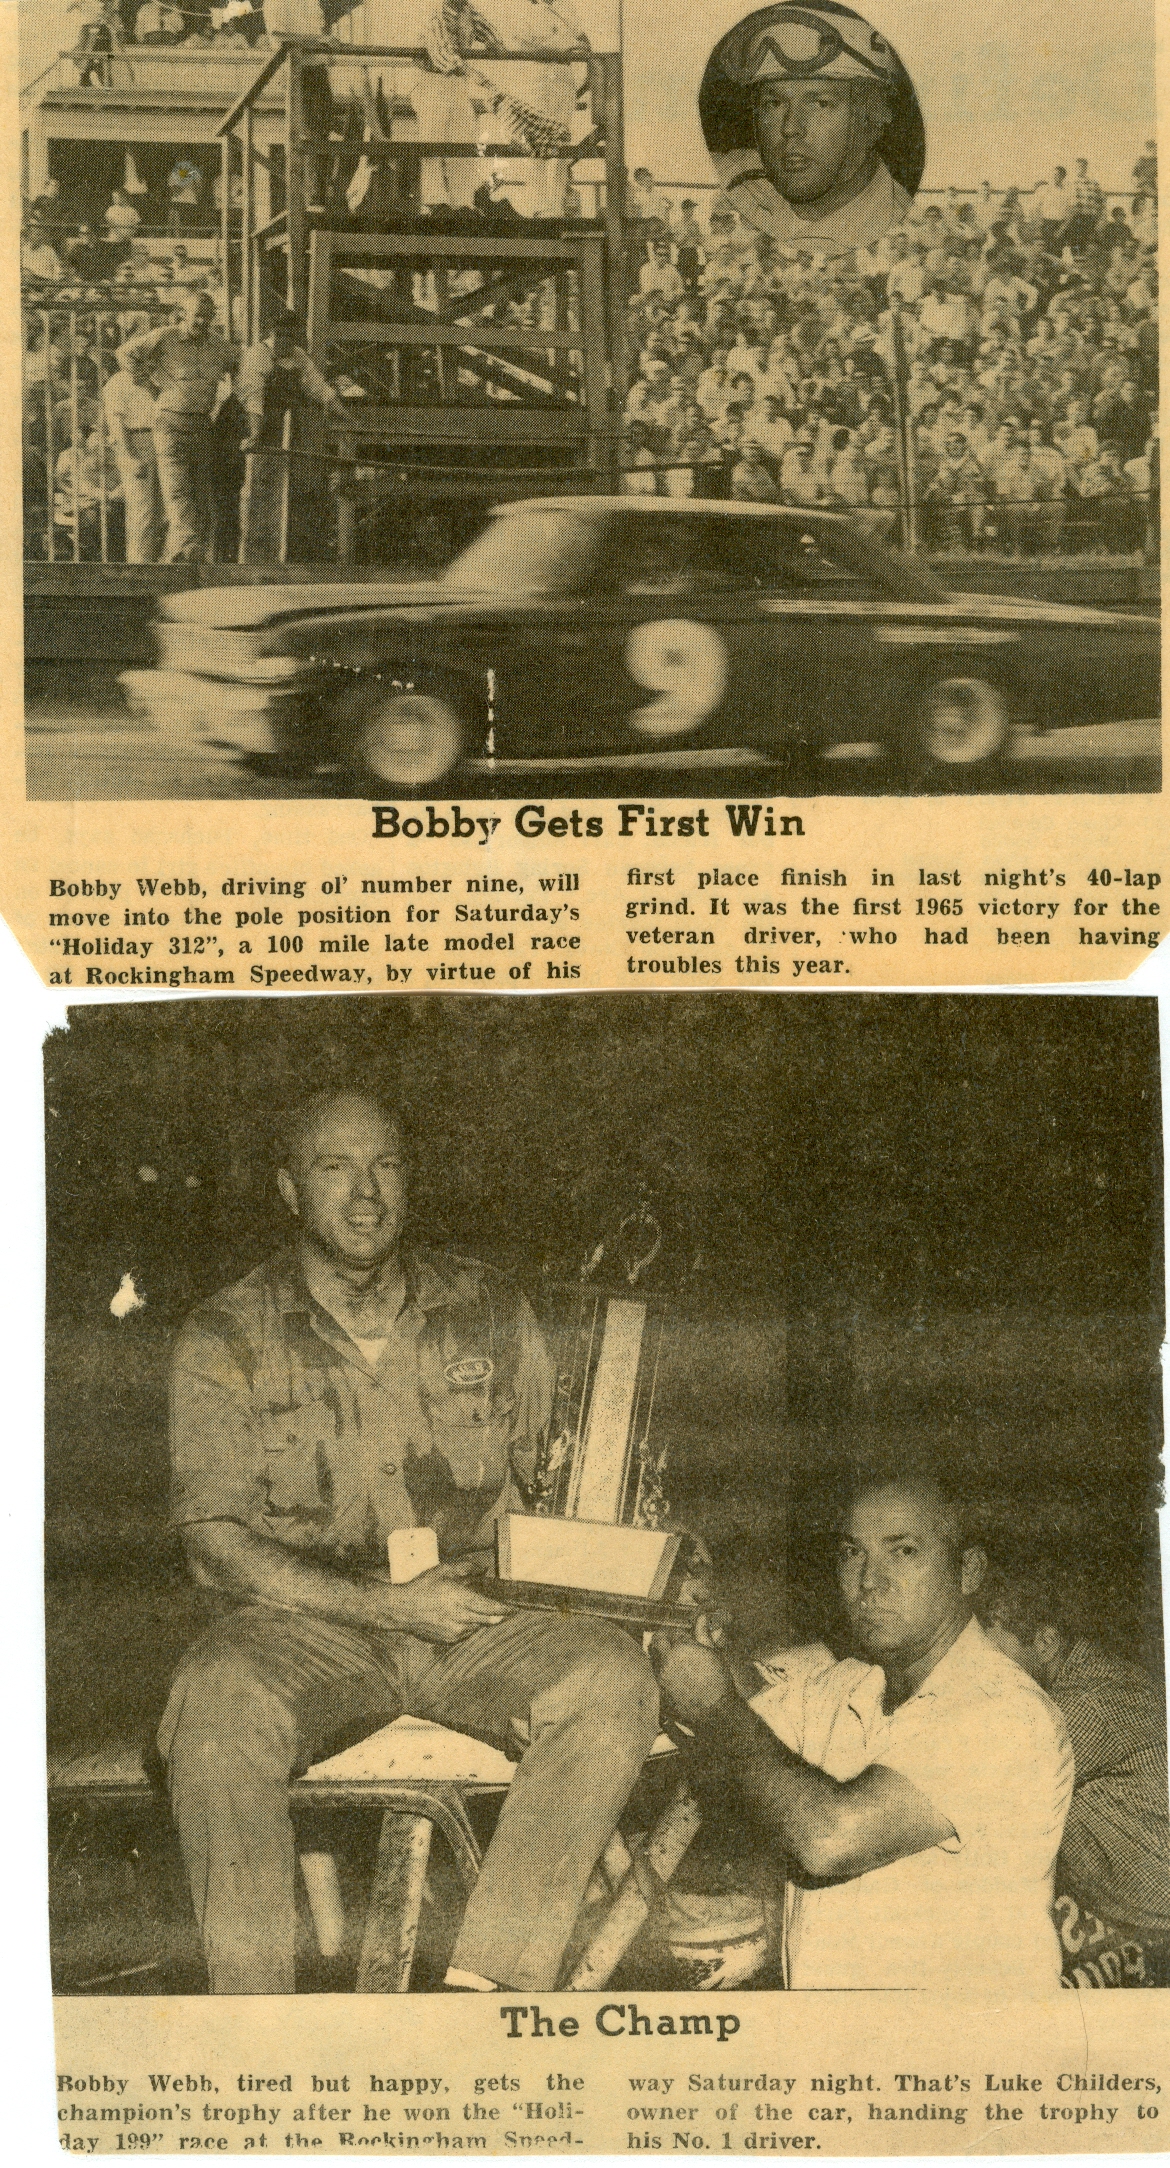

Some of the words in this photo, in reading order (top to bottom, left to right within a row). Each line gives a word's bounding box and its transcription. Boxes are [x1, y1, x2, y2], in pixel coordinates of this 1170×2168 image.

[624, 620, 727, 737] 9
[371, 804, 502, 845] Bobby
[514, 804, 604, 838] Gets
[617, 803, 710, 838] First
[725, 804, 806, 837] Win
[48, 878, 122, 901] Bobby
[135, 877, 207, 899] Webb,
[221, 876, 307, 899] driving
[361, 875, 453, 894] number
[466, 874, 524, 895] nine,
[538, 873, 580, 892] will
[626, 867, 676, 886] first
[697, 867, 759, 890] place
[780, 867, 848, 887] finish
[871, 868, 895, 887] in
[918, 868, 962, 887] last
[1087, 868, 1162, 891] 40-lap
[48, 912, 110, 927] move
[123, 907, 170, 927] into
[183, 907, 222, 926] the
[235, 906, 284, 929] pole
[297, 905, 392, 928] position
[406, 904, 440, 923] for
[625, 897, 695, 919] grind.
[709, 897, 730, 916] It
[742, 901, 787, 916] was
[800, 896, 840, 916] the
[852, 897, 902, 916] first
[915, 897, 964, 916] 1965
[977, 897, 1060, 920] victory
[1073, 897, 1109, 916] for
[1121, 897, 1160, 916] the
[238, 940, 253, 954] a
[267, 935, 304, 954] 100
[318, 934, 370, 953] mile
[384, 933, 429, 953] late
[444, 932, 515, 951] model
[530, 936, 581, 950] race
[625, 926, 716, 945] veteran
[744, 926, 821, 948] driver,
[848, 926, 898, 945] who
[924, 926, 969, 945] had
[996, 927, 1051, 945] been
[1078, 926, 1161, 949] having
[49, 967, 73, 985] at
[85, 965, 235, 988] Rockingham
[250, 964, 373, 987] Speedway,
[385, 963, 413, 984] by
[425, 962, 496, 981] virtue
[508, 961, 532, 980] of
[546, 960, 582, 979] his
[626, 955, 722, 974] troubles
[734, 954, 781, 975] this
[792, 959, 850, 978] year.
[500, 2005, 580, 2039] The
[595, 2003, 741, 2043] Champ
[56, 2074, 130, 2096] Bobby
[147, 2074, 219, 2095] Webb,
[236, 2073, 293, 2092] tired
[310, 2074, 351, 2093] but
[369, 2074, 450, 2096] happy,
[474, 2073, 521, 2096] gets
[546, 2073, 585, 2091] the
[628, 2078, 675, 2095] way
[688, 2073, 797, 2095] Saturday
[810, 2073, 881, 2096] night.
[984, 2073, 1043, 2092] Luke
[1056, 2073, 1162, 2095] Childers,
[202, 2103, 281, 2126] trophy
[292, 2103, 352, 2122] after
[363, 2104, 391, 2122] he
[403, 2107, 451, 2121] won
[462, 2102, 500, 2121] the
[626, 2107, 699, 2121] owner
[715, 2103, 739, 2121] of
[754, 2103, 793, 2121] the
[808, 2107, 852, 2124] car,
[867, 2103, 969, 2125] handing
[984, 2103, 1024, 2121] the
[1039, 2103, 1119, 2125] trophy
[1137, 2104, 1159, 2120] to
[59, 2132, 100, 2154] day
[179, 2136, 228, 2151] race
[243, 2132, 268, 2150] at
[284, 2132, 323, 2148] the
[626, 2131, 662, 2150] his
[672, 2132, 711, 2150] No.
[721, 2132, 733, 2150] 1
[744, 2131, 822, 2150] driver.
